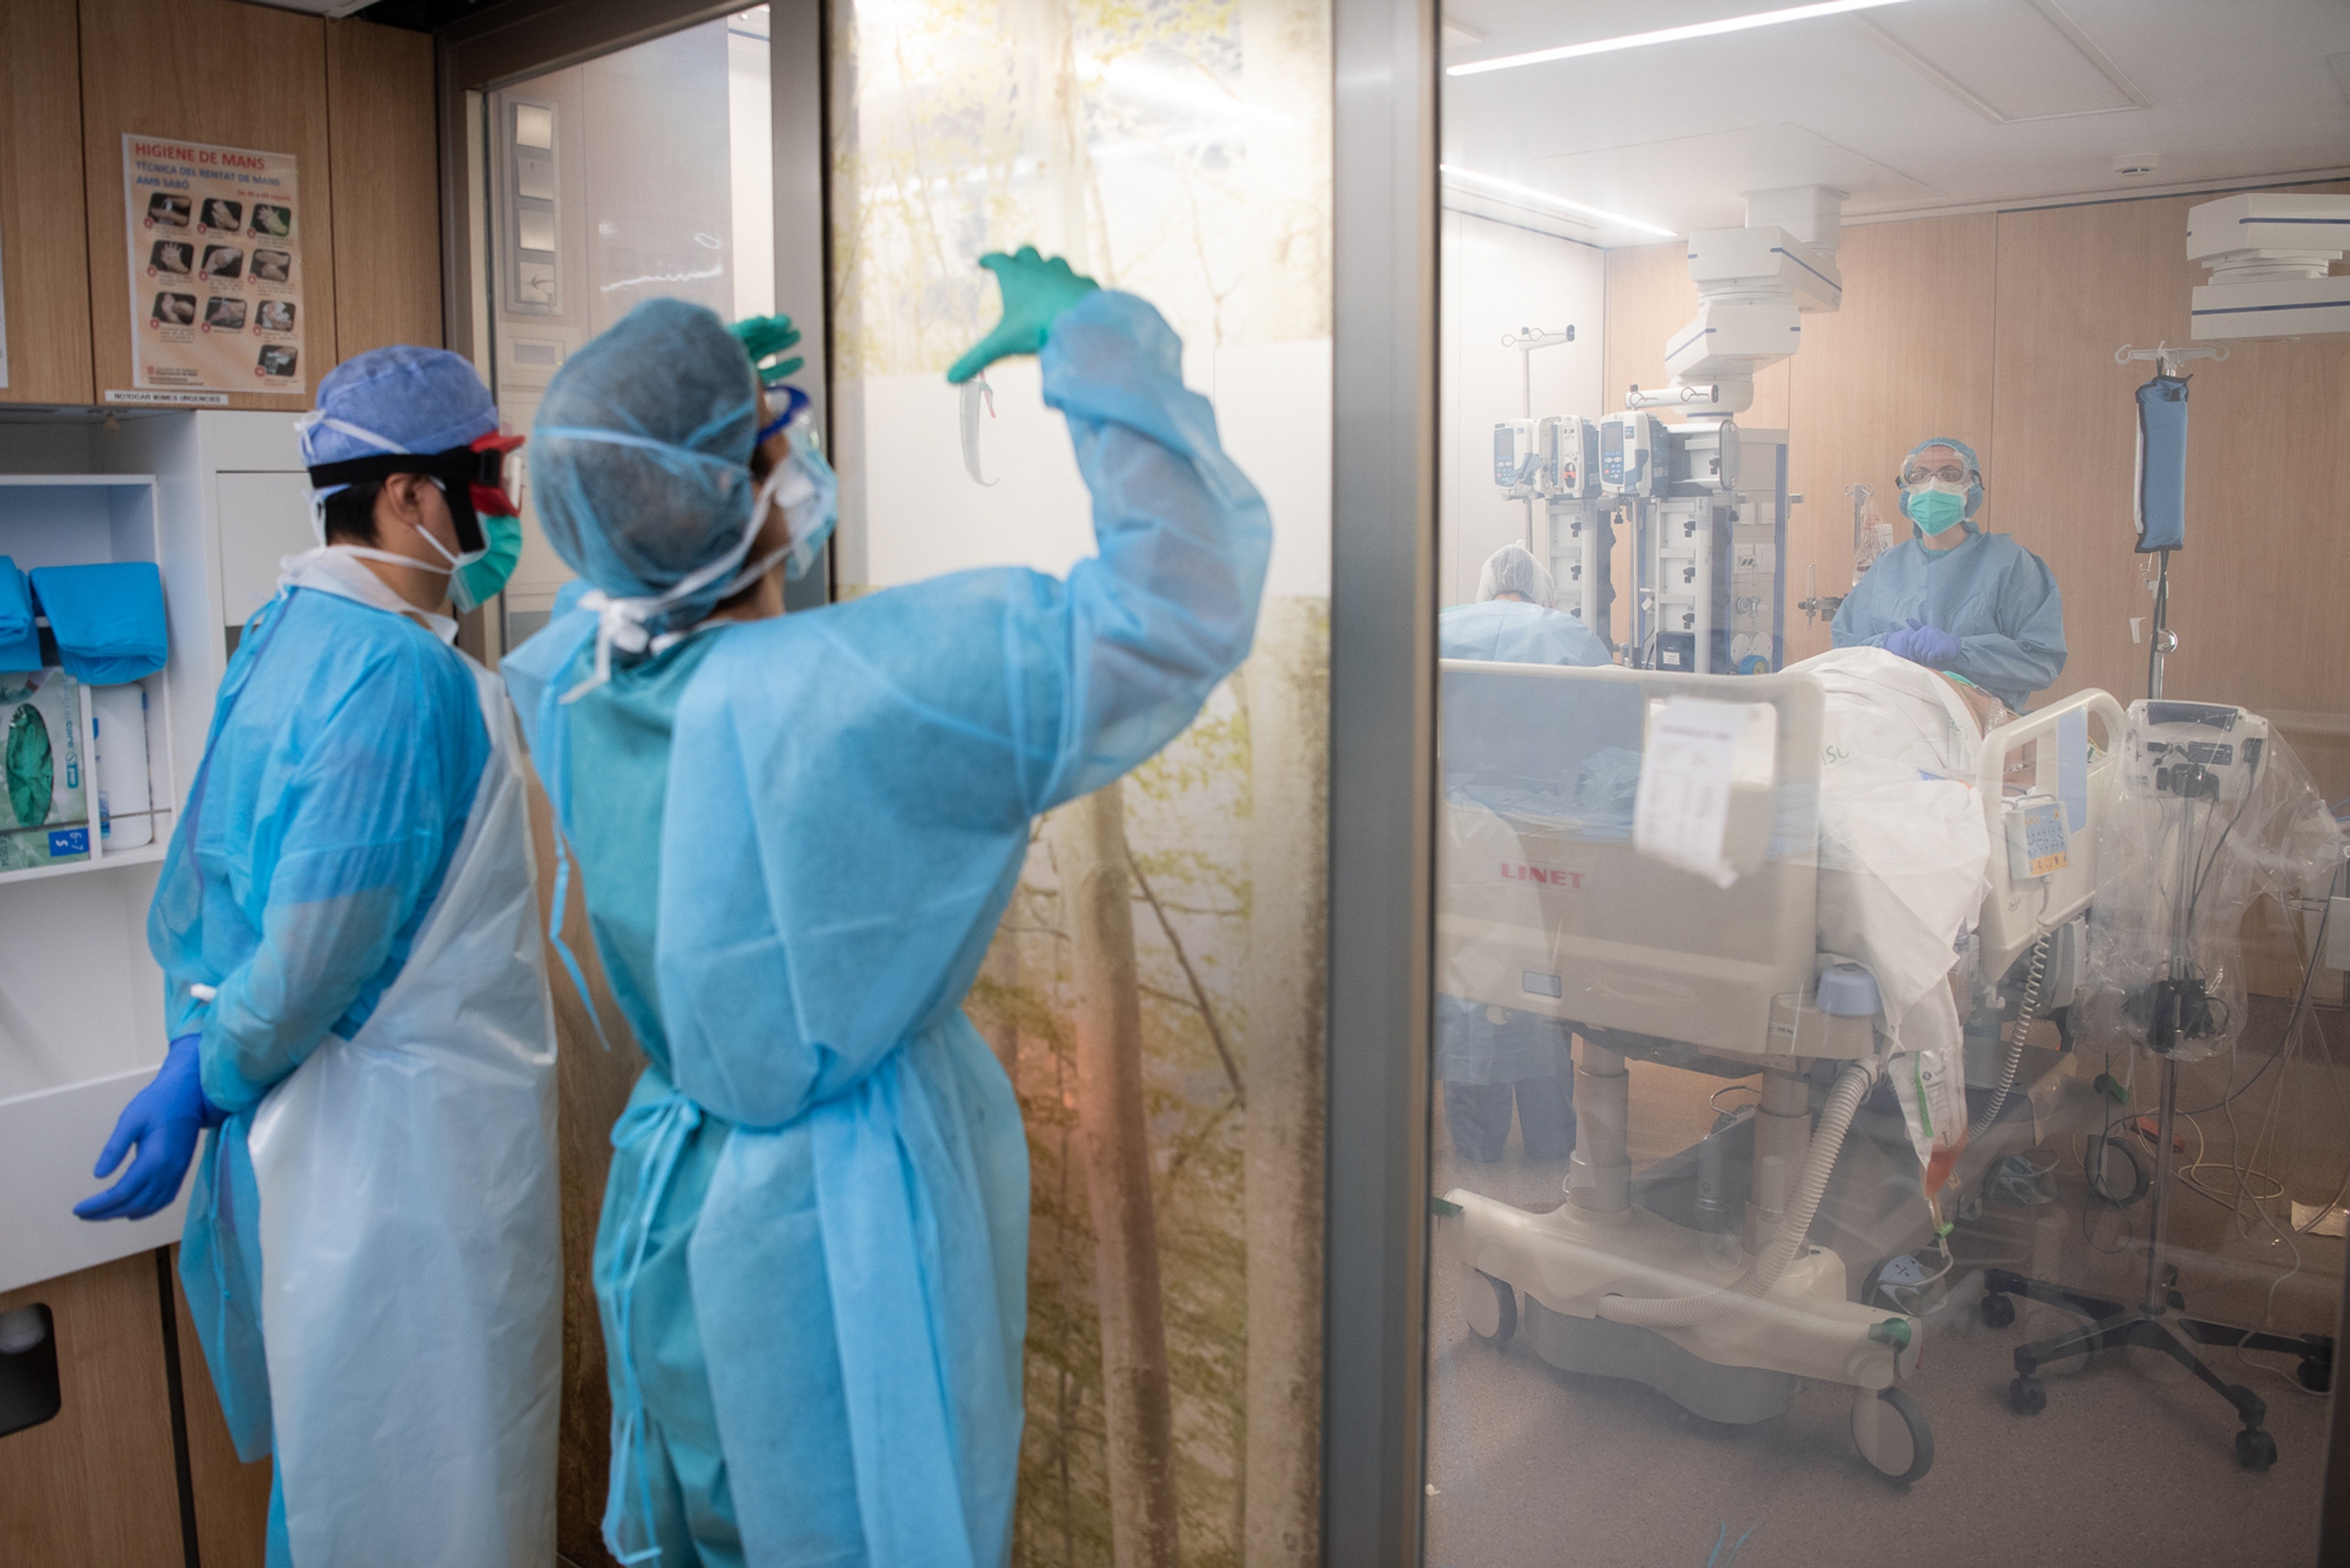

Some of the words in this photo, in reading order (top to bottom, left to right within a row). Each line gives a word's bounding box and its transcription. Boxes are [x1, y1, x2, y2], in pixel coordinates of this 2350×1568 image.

[135, 143, 195, 162] HIGIENE
[199, 152, 218, 165] DE
[222, 154, 264, 170] MANS
[136, 175, 160, 186] AMB
[179, 166, 197, 177] DEL
[199, 169, 236, 182] RENTAT
[238, 173, 250, 183] DE
[252, 174, 280, 187] MANS
[1501, 863, 1585, 888] LINET
